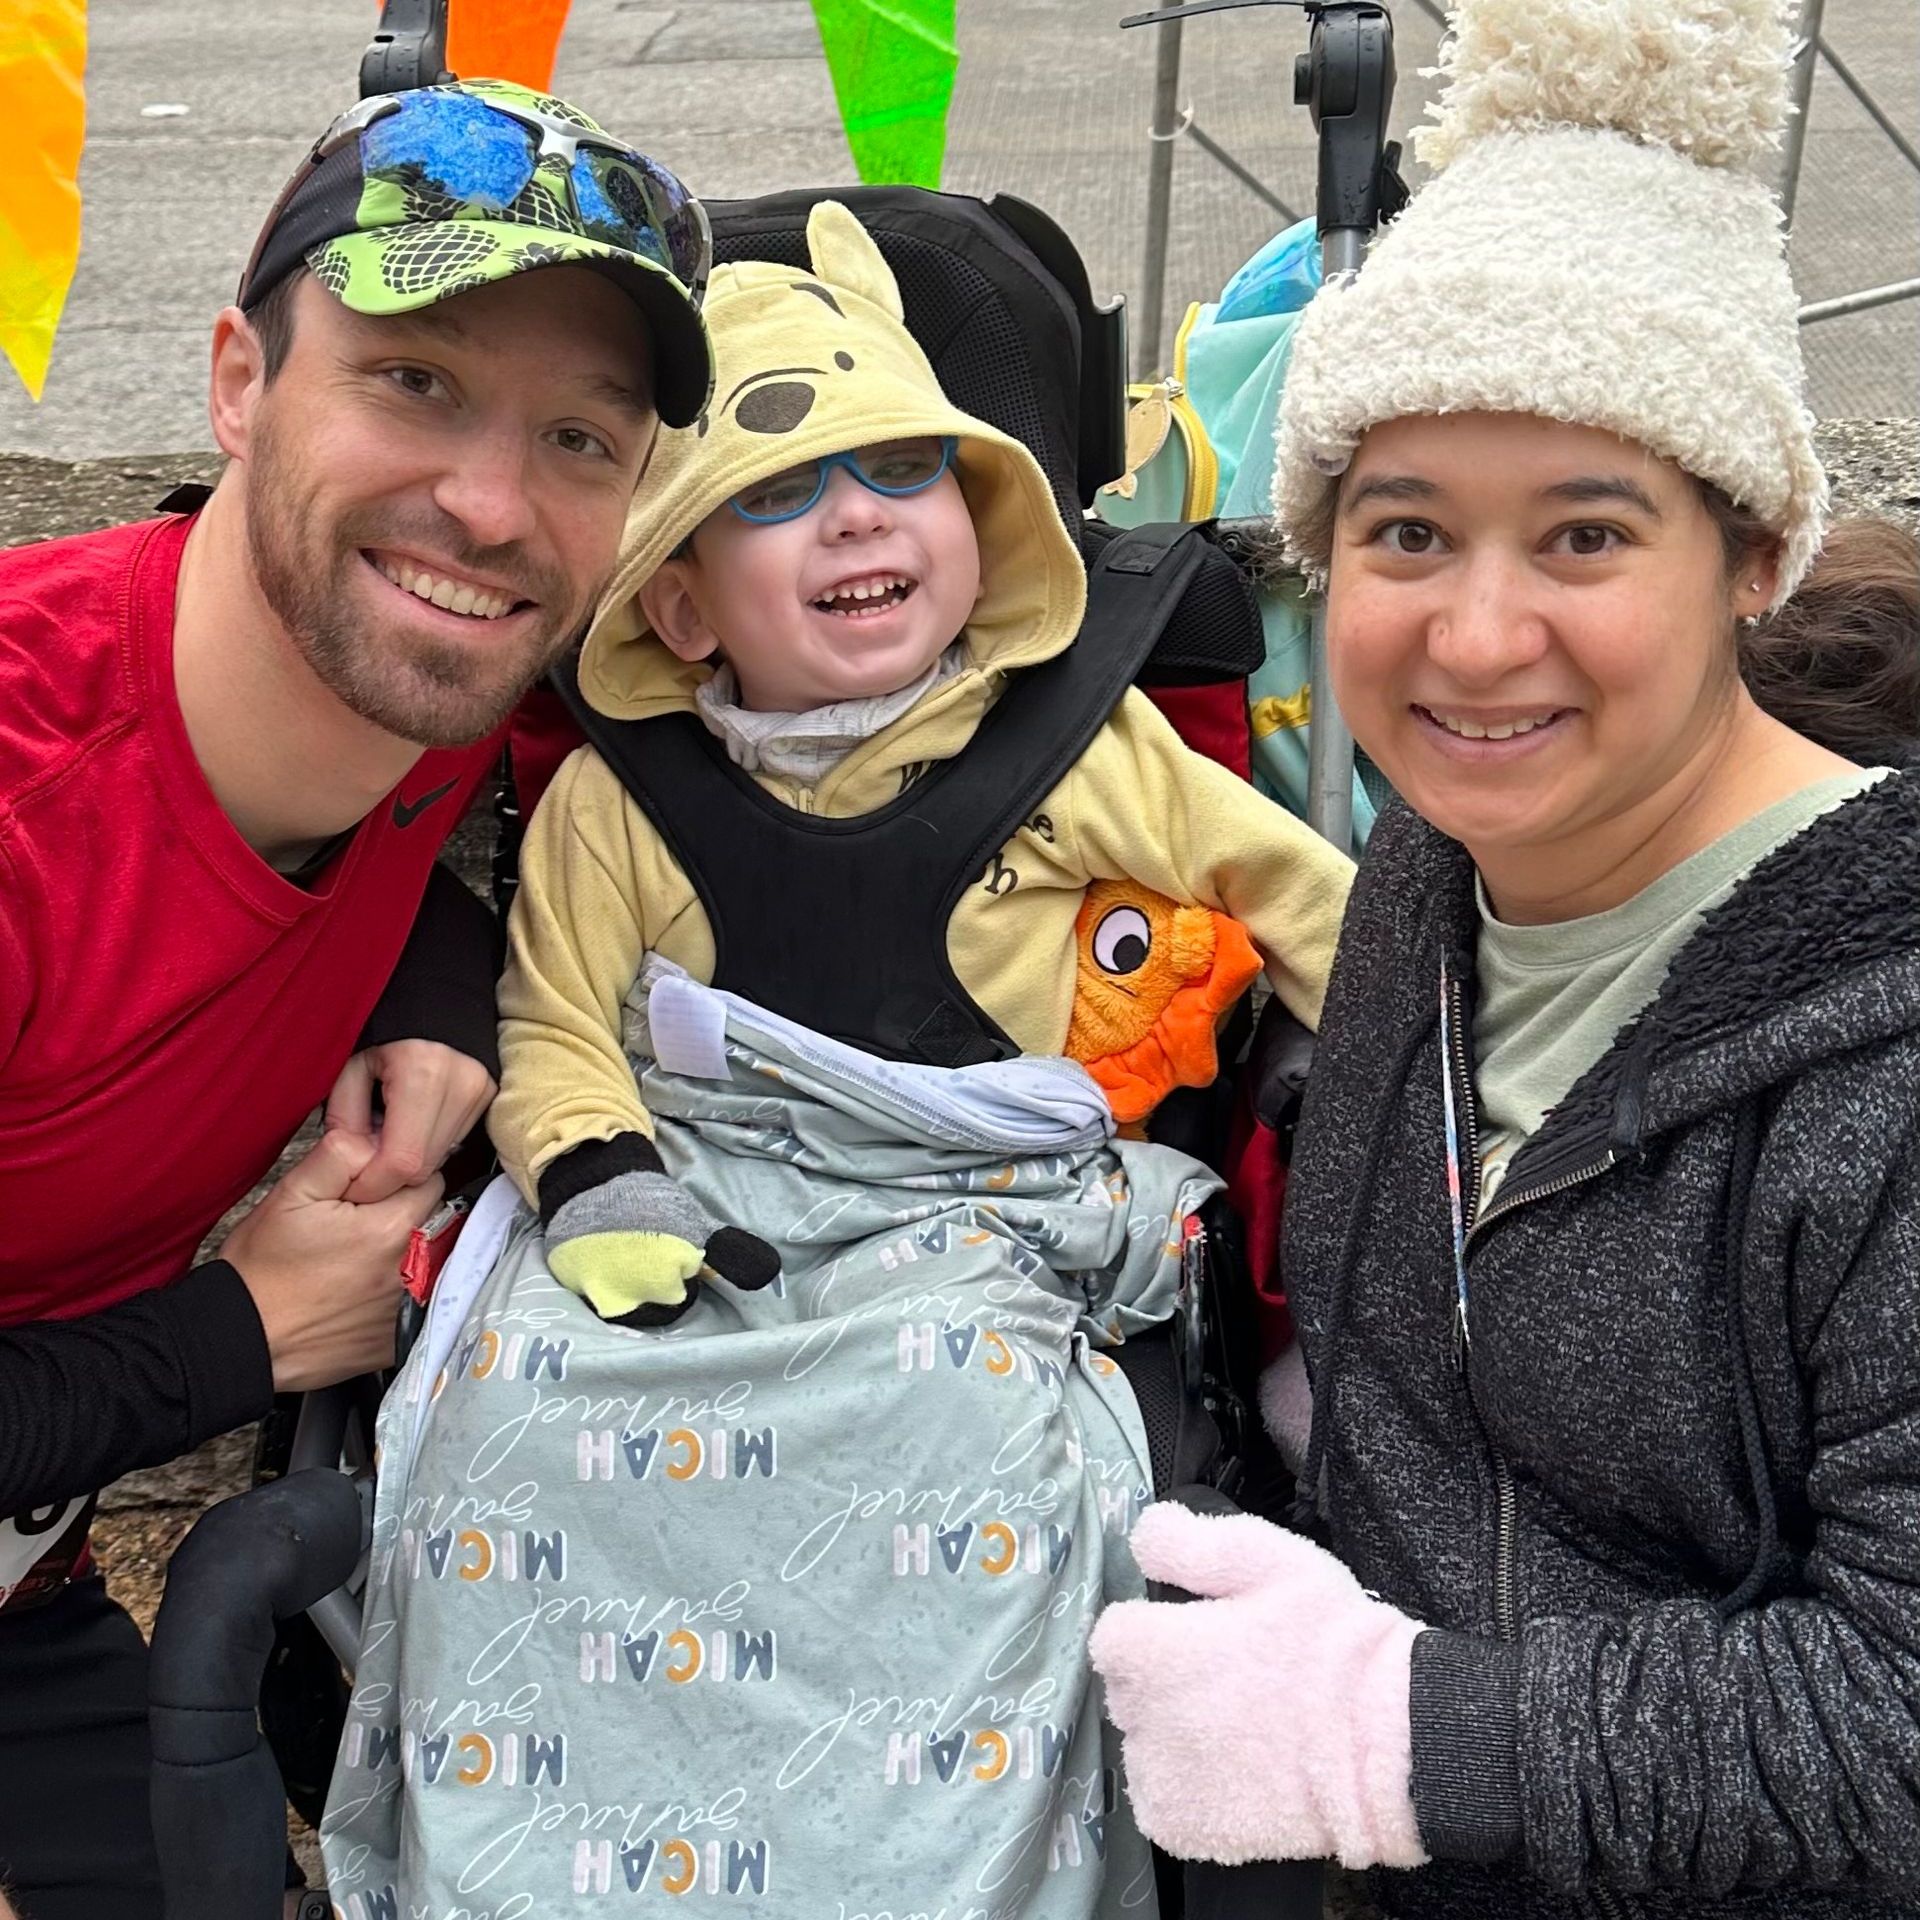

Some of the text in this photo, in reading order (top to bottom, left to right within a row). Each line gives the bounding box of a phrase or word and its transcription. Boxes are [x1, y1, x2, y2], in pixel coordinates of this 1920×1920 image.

[456, 1329, 574, 1382] MICA
[576, 1427, 777, 1481] MICAH
[579, 1628, 777, 1684] MICAH
[885, 1723, 1073, 1785] MICAH
[573, 1839, 770, 1895] MICAH
